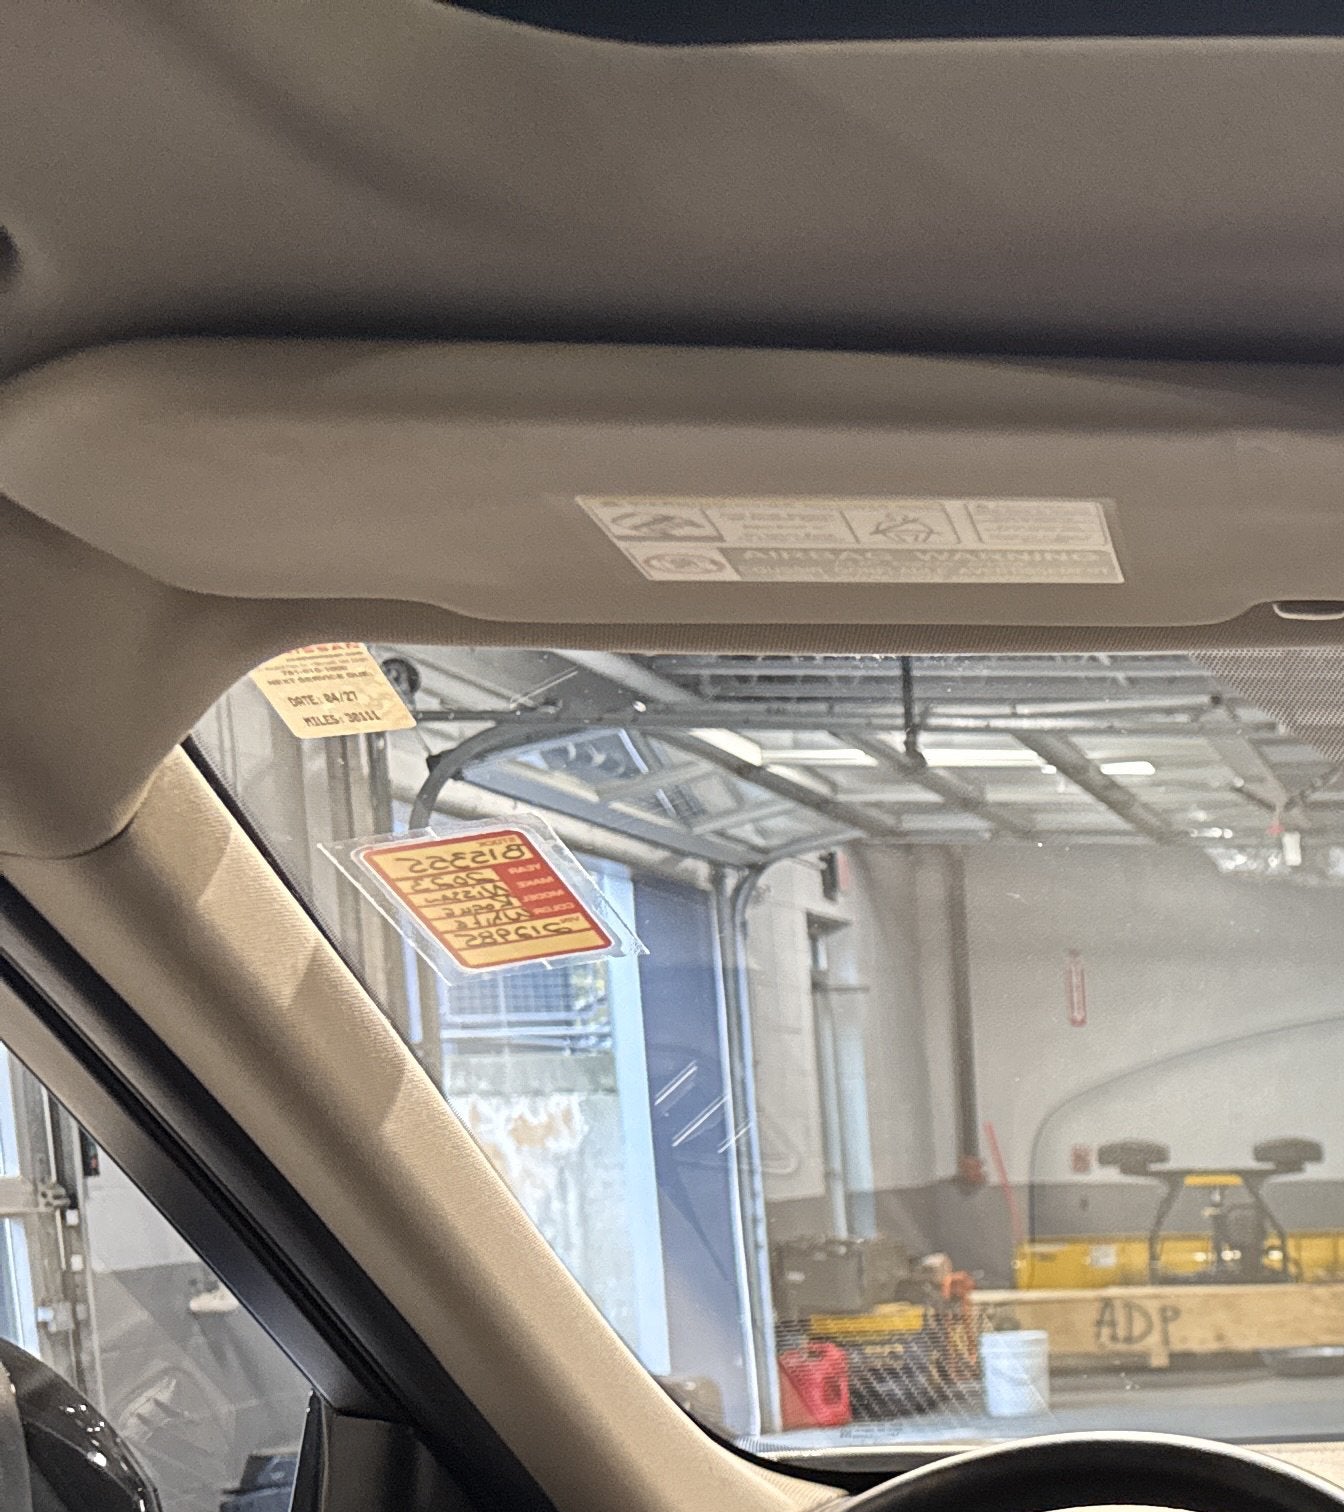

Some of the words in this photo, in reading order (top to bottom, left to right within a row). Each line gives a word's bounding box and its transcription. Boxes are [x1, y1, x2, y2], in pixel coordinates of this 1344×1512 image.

[288, 695, 321, 708] DATE:
[323, 691, 358, 704] 04/27
[303, 714, 343, 727] MILES:
[1095, 1298, 1182, 1346] ADP
